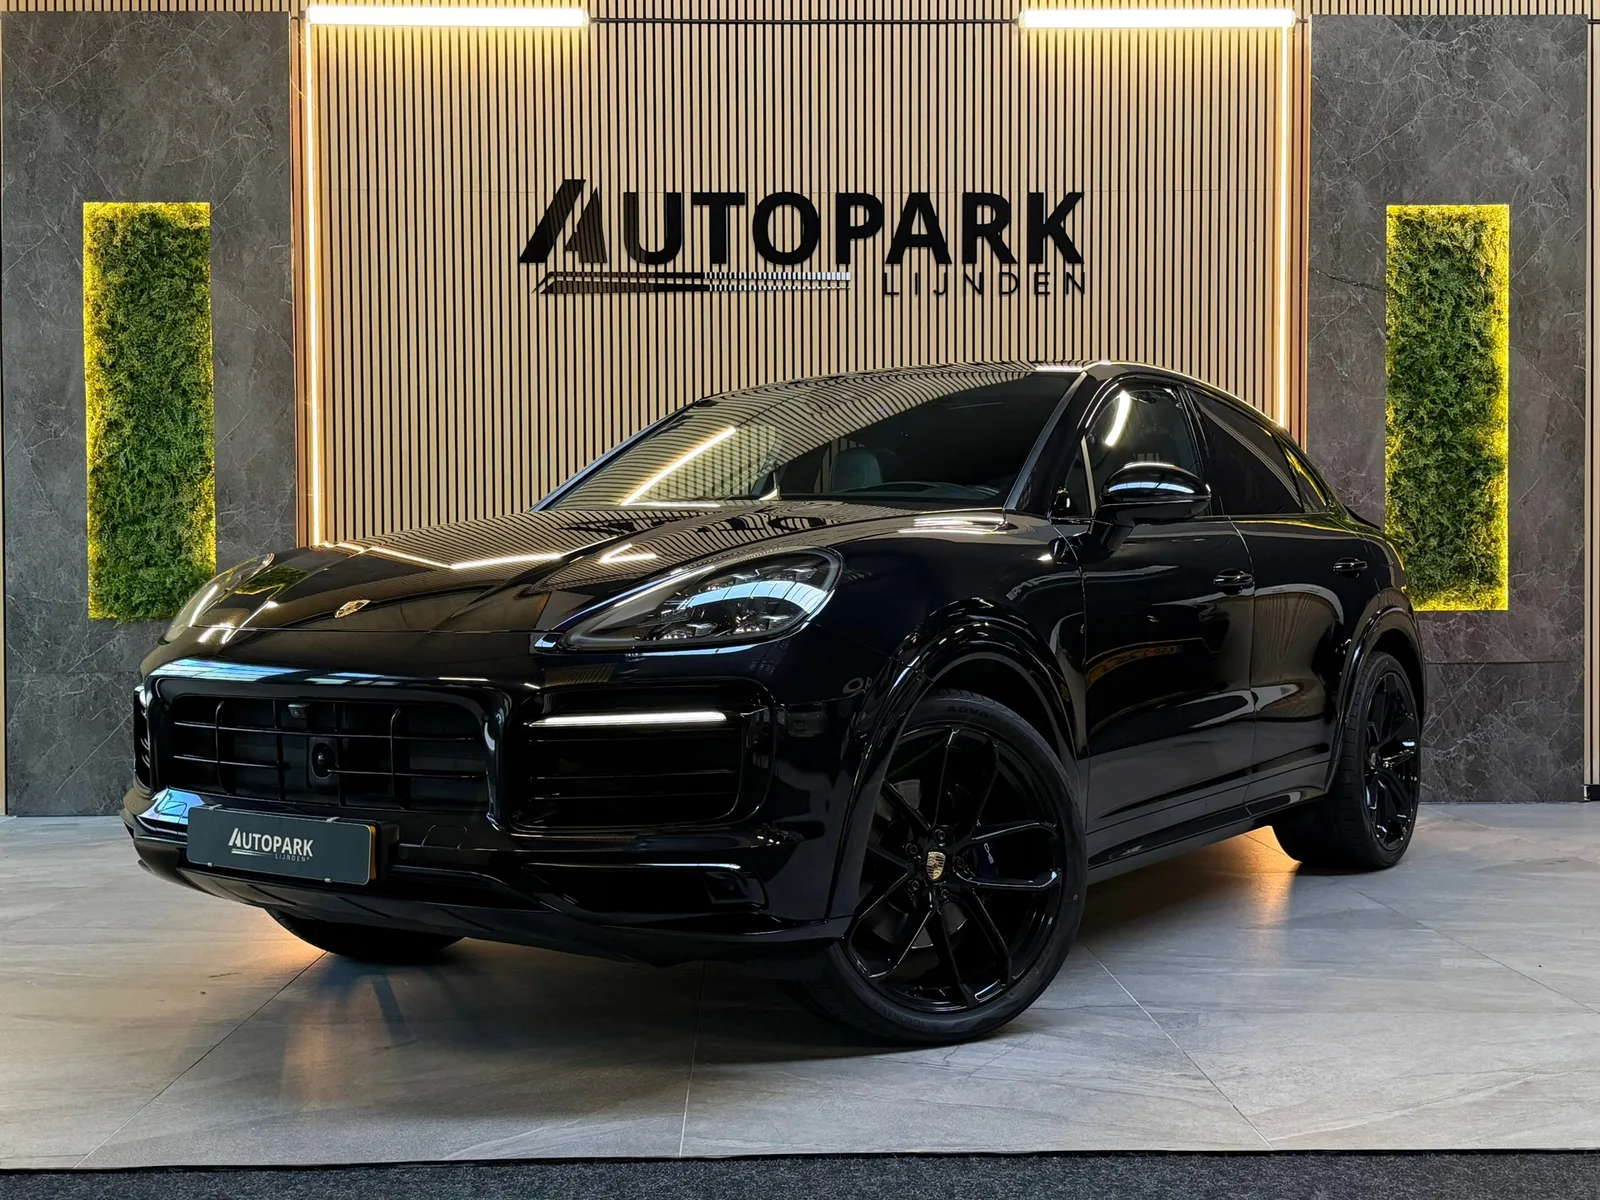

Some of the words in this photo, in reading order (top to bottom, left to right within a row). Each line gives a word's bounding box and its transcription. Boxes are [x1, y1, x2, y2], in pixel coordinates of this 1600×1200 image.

[519, 179, 1084, 265] AUTOPARK
[883, 272, 1086, 296] LIJNDEN
[228, 828, 314, 857] AUTOPARK
